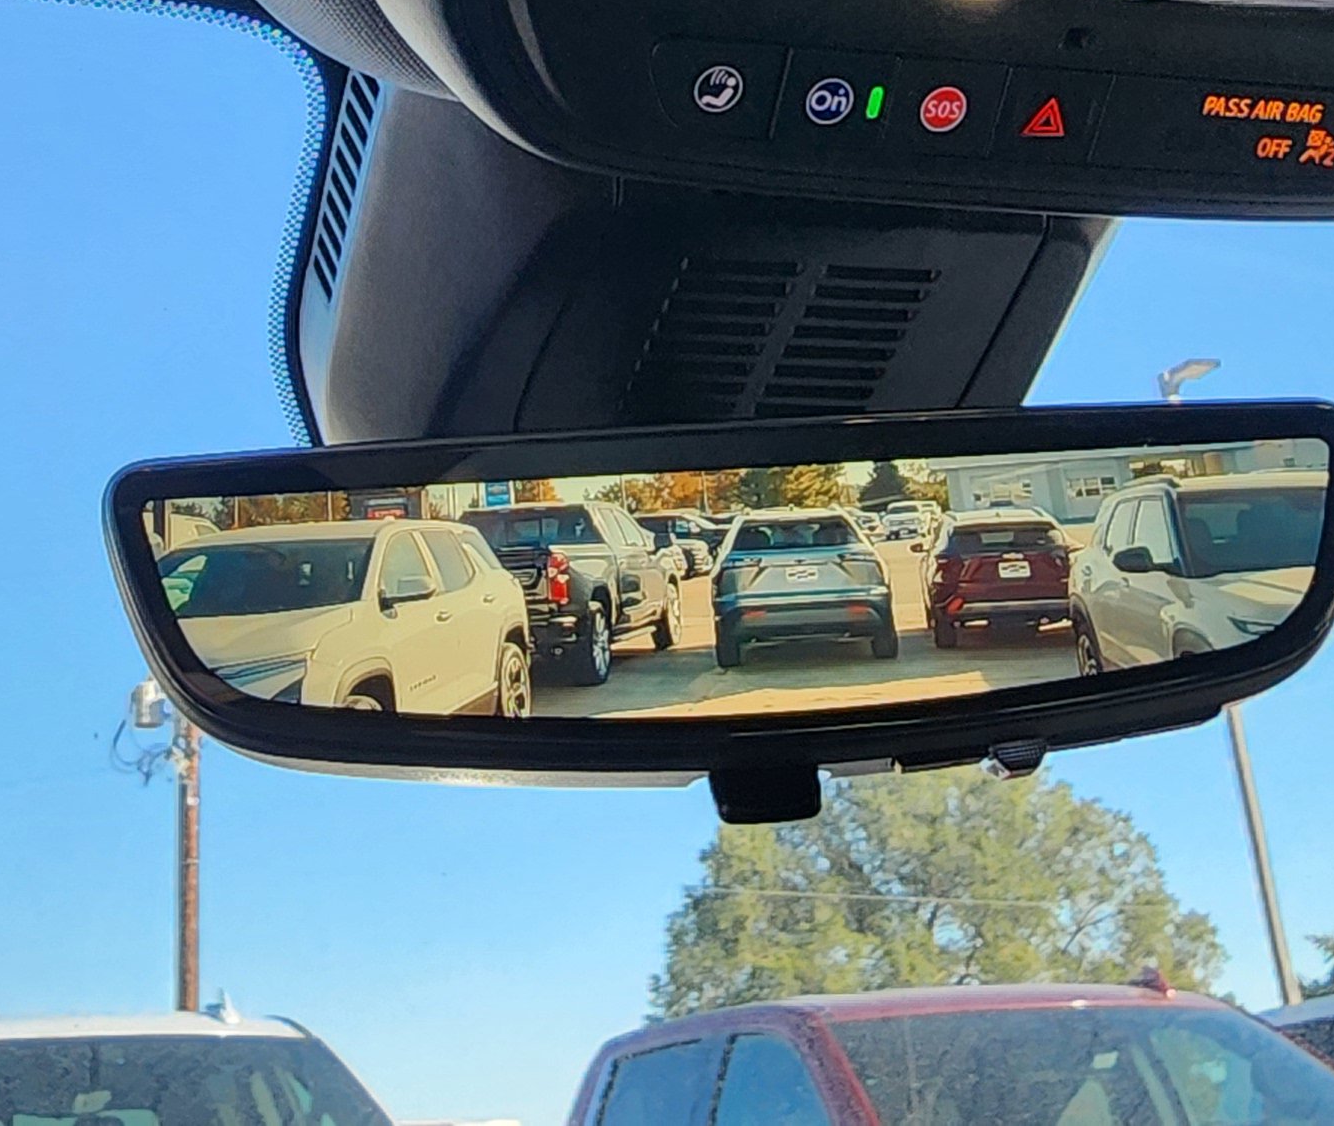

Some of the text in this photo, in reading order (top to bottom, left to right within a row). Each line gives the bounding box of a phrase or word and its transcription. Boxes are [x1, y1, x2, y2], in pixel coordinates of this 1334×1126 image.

[925, 99, 962, 120] SOS
[1201, 95, 1325, 124] PASS AIR BAG
[1255, 137, 1293, 160] OFF
